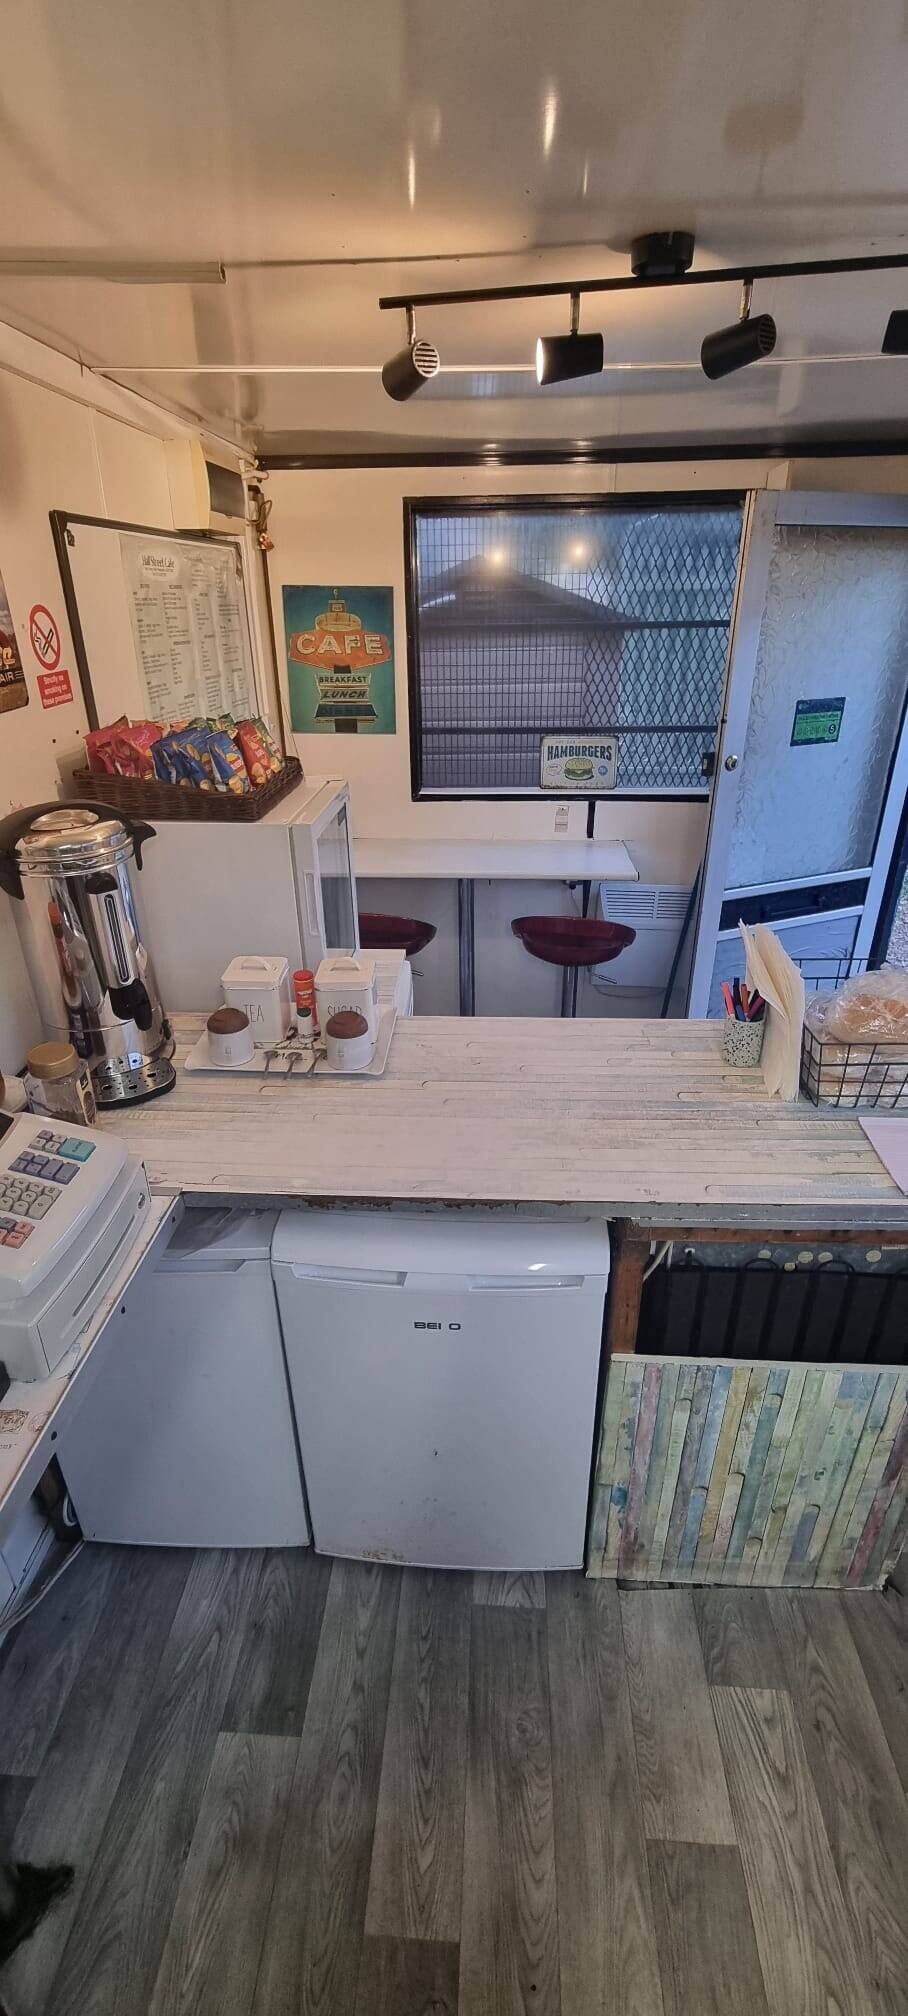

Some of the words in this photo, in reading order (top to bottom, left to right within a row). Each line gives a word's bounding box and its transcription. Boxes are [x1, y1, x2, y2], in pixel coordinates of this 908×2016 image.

[296, 634, 383, 655] CAFE
[321, 690, 367, 699] LUNCH
[547, 745, 613, 761] HAMBURGERS
[243, 1004, 265, 1023] TEA
